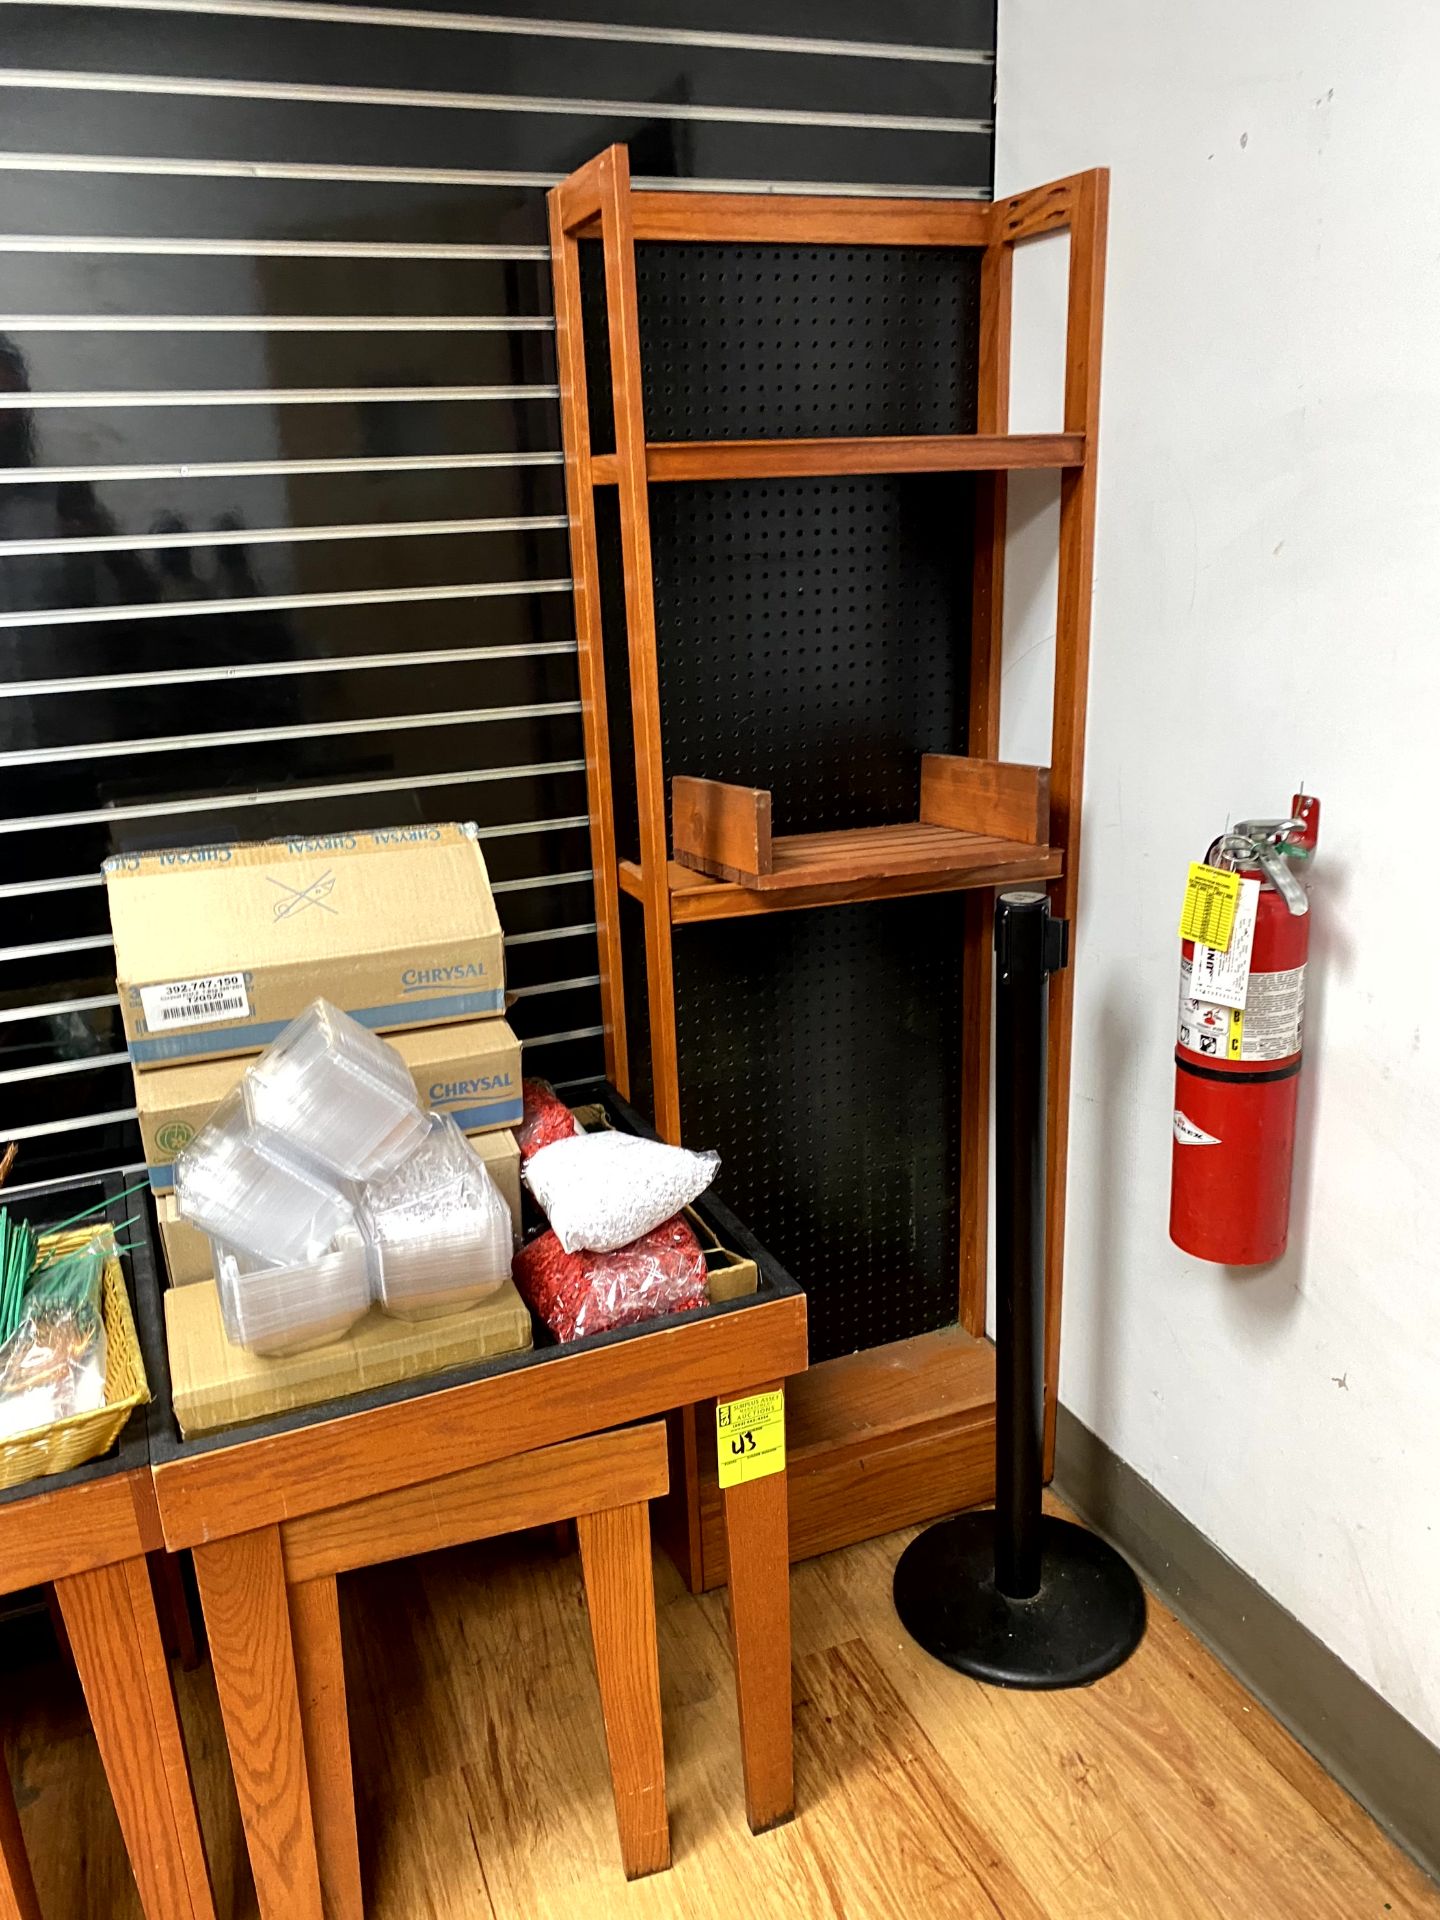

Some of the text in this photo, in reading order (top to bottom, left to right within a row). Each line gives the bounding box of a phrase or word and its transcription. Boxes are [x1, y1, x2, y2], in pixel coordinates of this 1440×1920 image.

[401, 962, 488, 986] CHRYSAL
[165, 975, 239, 996] 392.747.150
[1231, 1038, 1239, 1051] C
[428, 1071, 513, 1100] CHRYSAL
[736, 1404, 775, 1421] AUCTIONS
